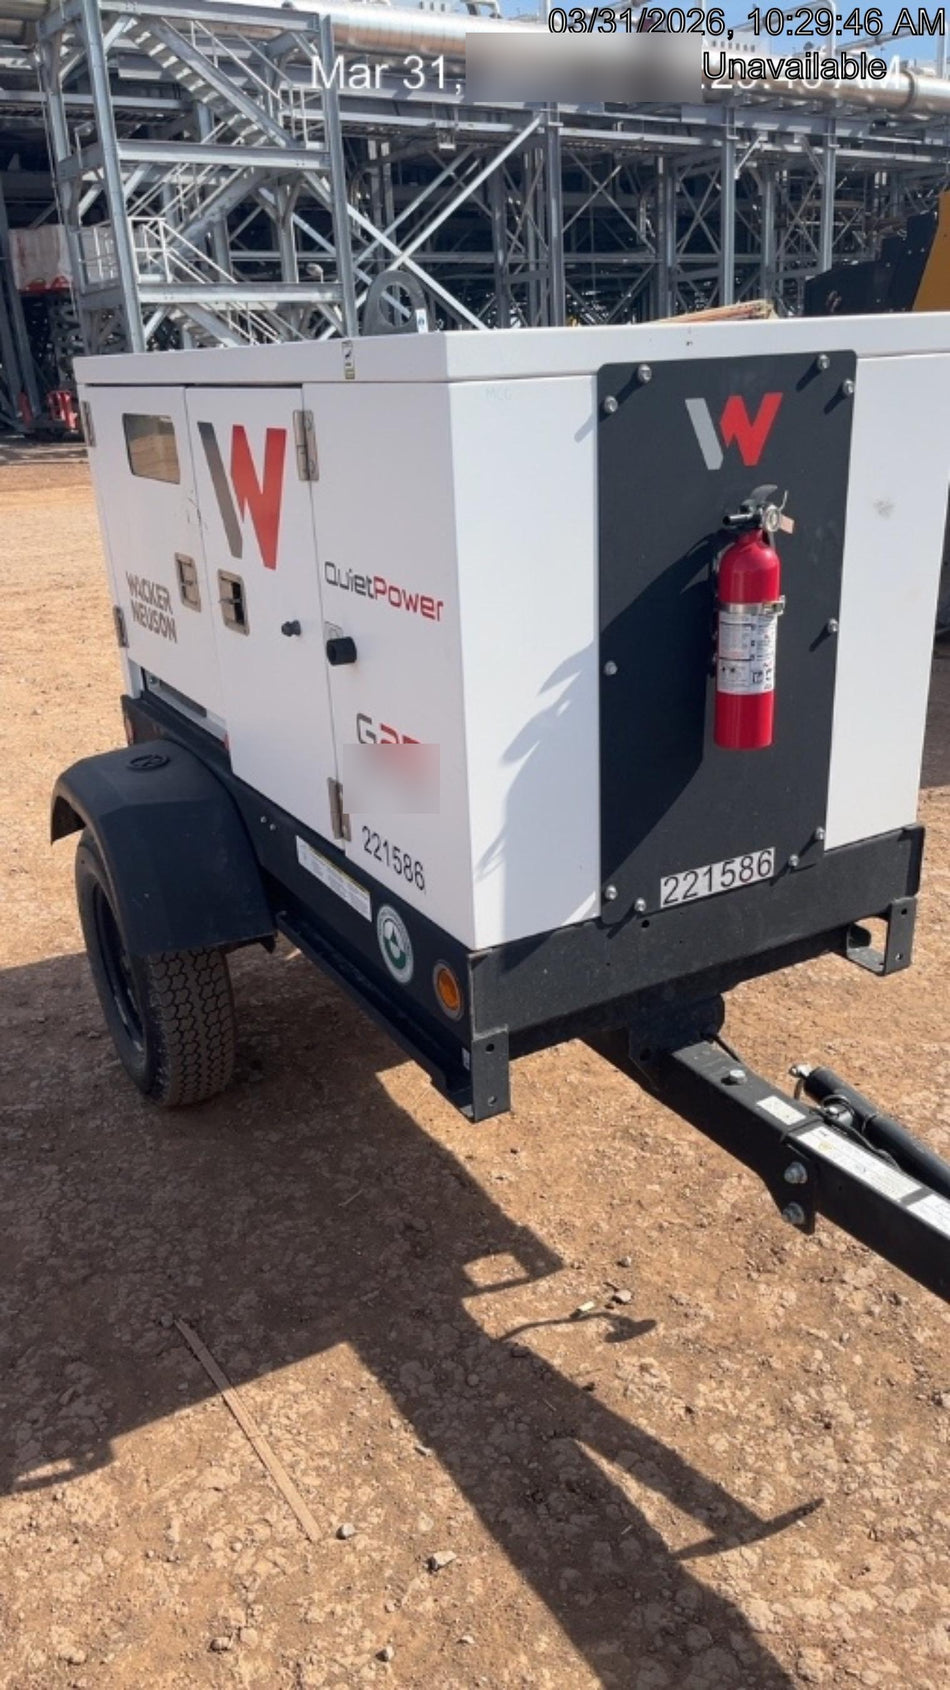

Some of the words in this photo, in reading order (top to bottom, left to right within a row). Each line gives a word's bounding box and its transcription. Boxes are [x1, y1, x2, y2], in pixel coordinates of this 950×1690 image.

[125, 570, 173, 615] WACKER
[324, 561, 444, 622] QuietPower
[130, 599, 178, 643] NEUSON
[361, 825, 425, 890] 221586
[662, 850, 772, 904] 221586
